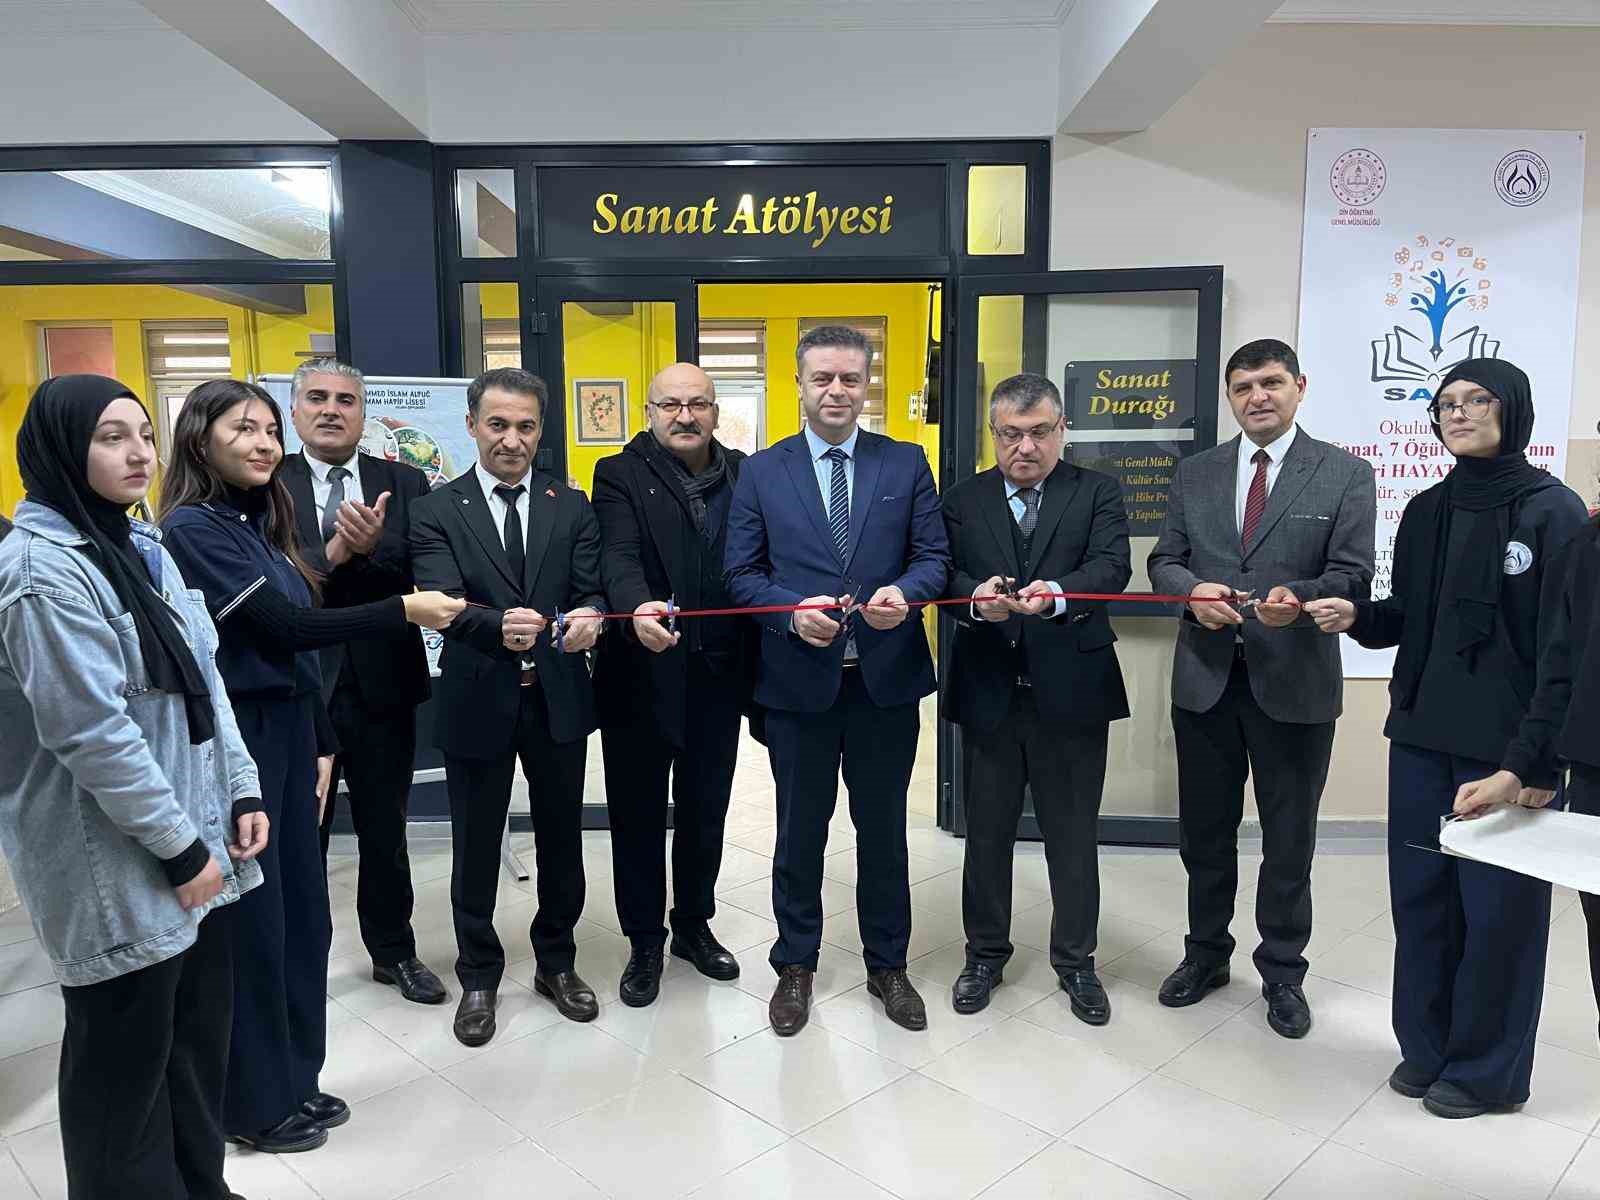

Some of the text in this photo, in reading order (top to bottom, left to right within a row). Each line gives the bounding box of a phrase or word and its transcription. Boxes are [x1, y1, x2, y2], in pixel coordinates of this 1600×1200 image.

[593, 190, 894, 249] Sanat Atölyesi
[1096, 369, 1172, 389] Sanat
[1383, 387, 1433, 401] SA
[1088, 395, 1175, 420] Durağı
[1380, 420, 1433, 435] Okulu
[1391, 442, 1399, 456] 7
[1150, 455, 1174, 468] Müdü
[1153, 474, 1170, 485] San
